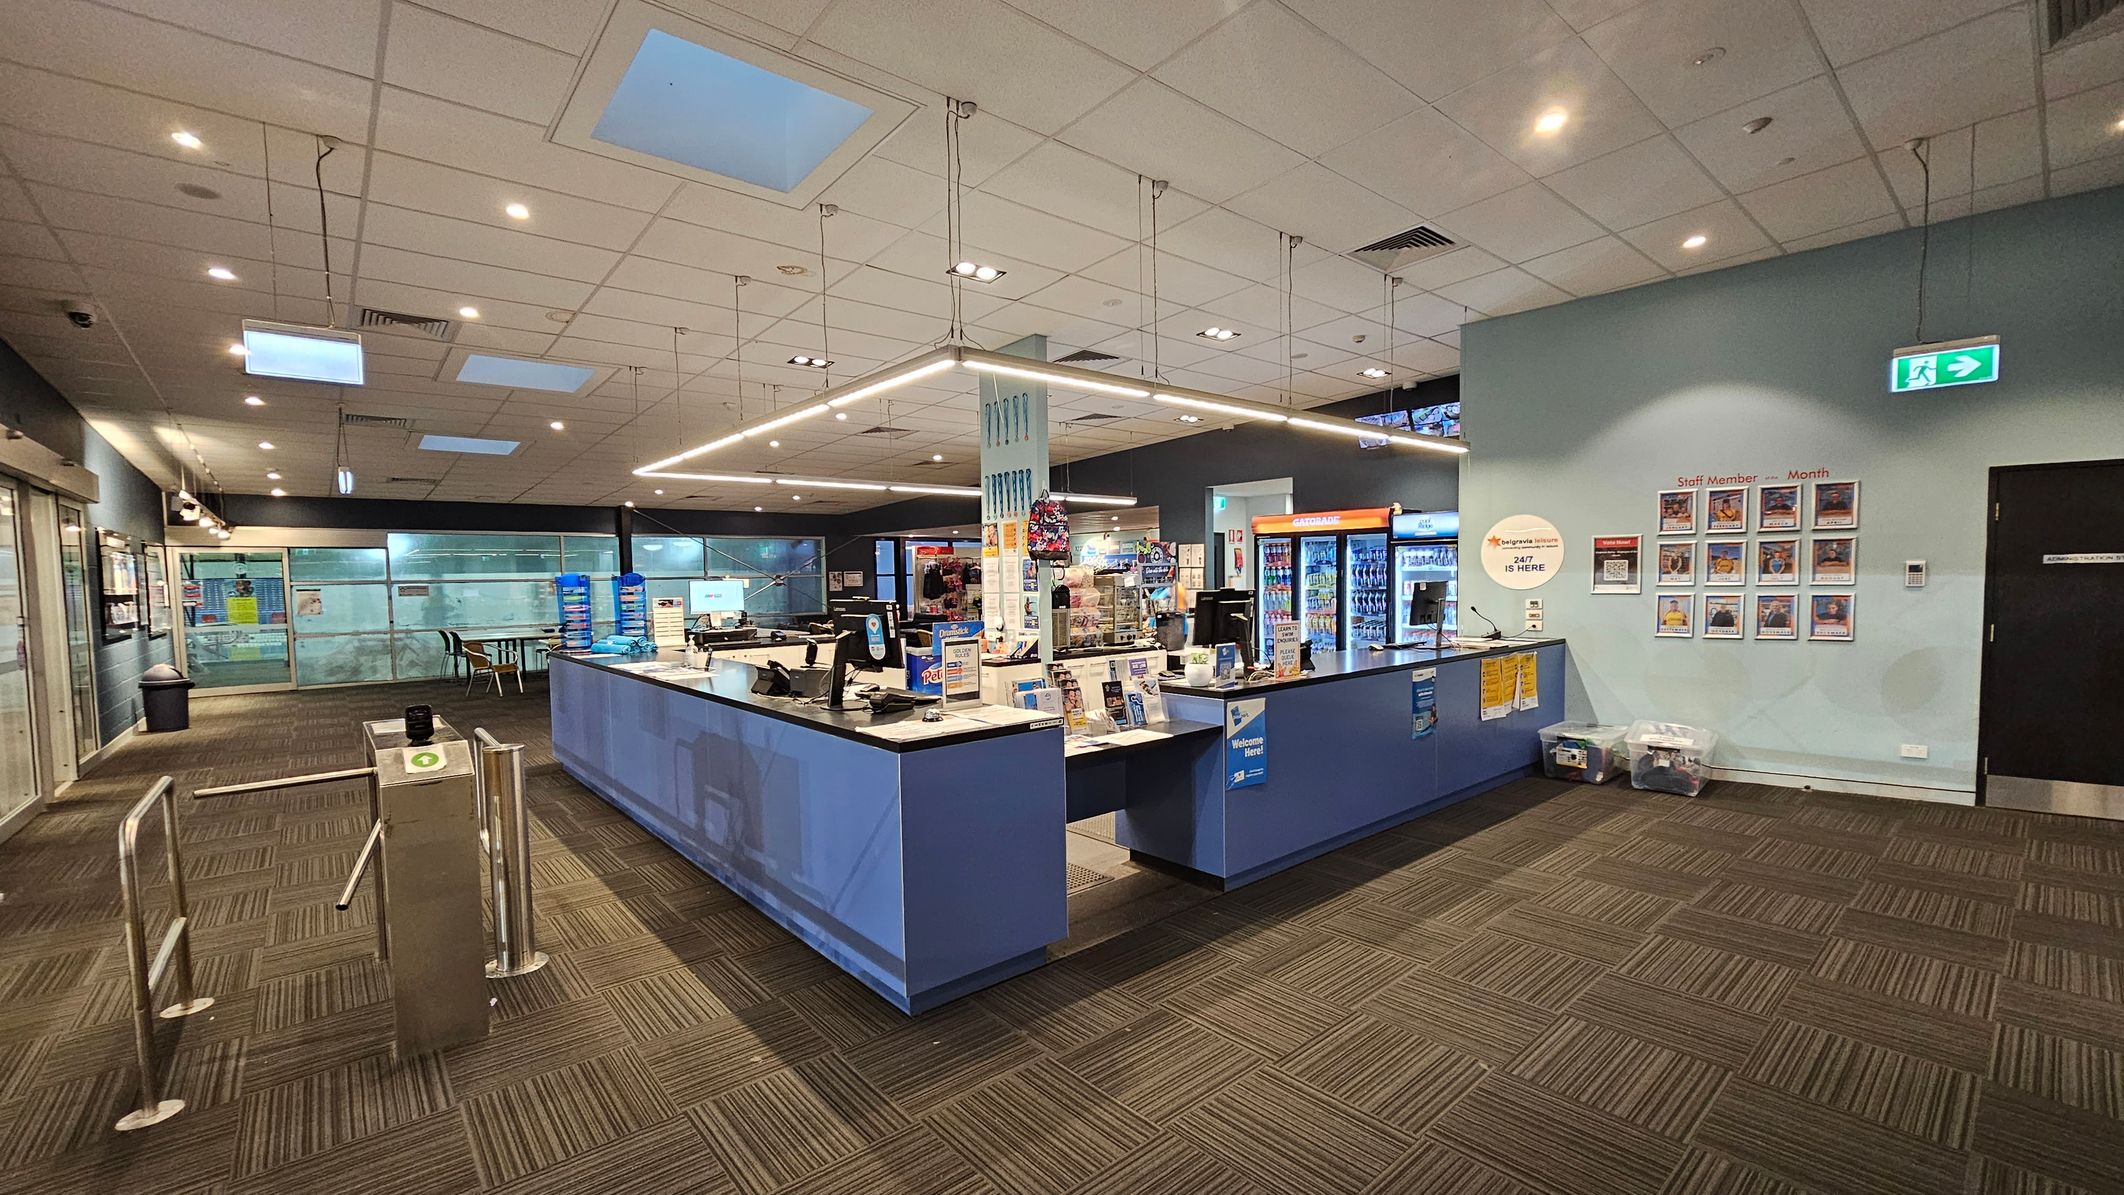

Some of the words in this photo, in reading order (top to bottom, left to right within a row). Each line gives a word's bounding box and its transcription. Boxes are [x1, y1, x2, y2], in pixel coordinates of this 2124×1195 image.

[1677, 475, 1704, 487] Staff
[1707, 473, 1758, 486] Member
[1787, 467, 1829, 480] Month
[1292, 516, 1341, 527] GATORADE
[1501, 538, 1533, 546] belgravia
[1513, 555, 1534, 564] 24/7
[1505, 564, 1515, 572] IS
[1517, 563, 1546, 572] HERE
[939, 626, 969, 638] Drumstick
[922, 667, 943, 685] Pet
[1231, 736, 1264, 750] Welcome
[1244, 745, 1264, 758] Here!
